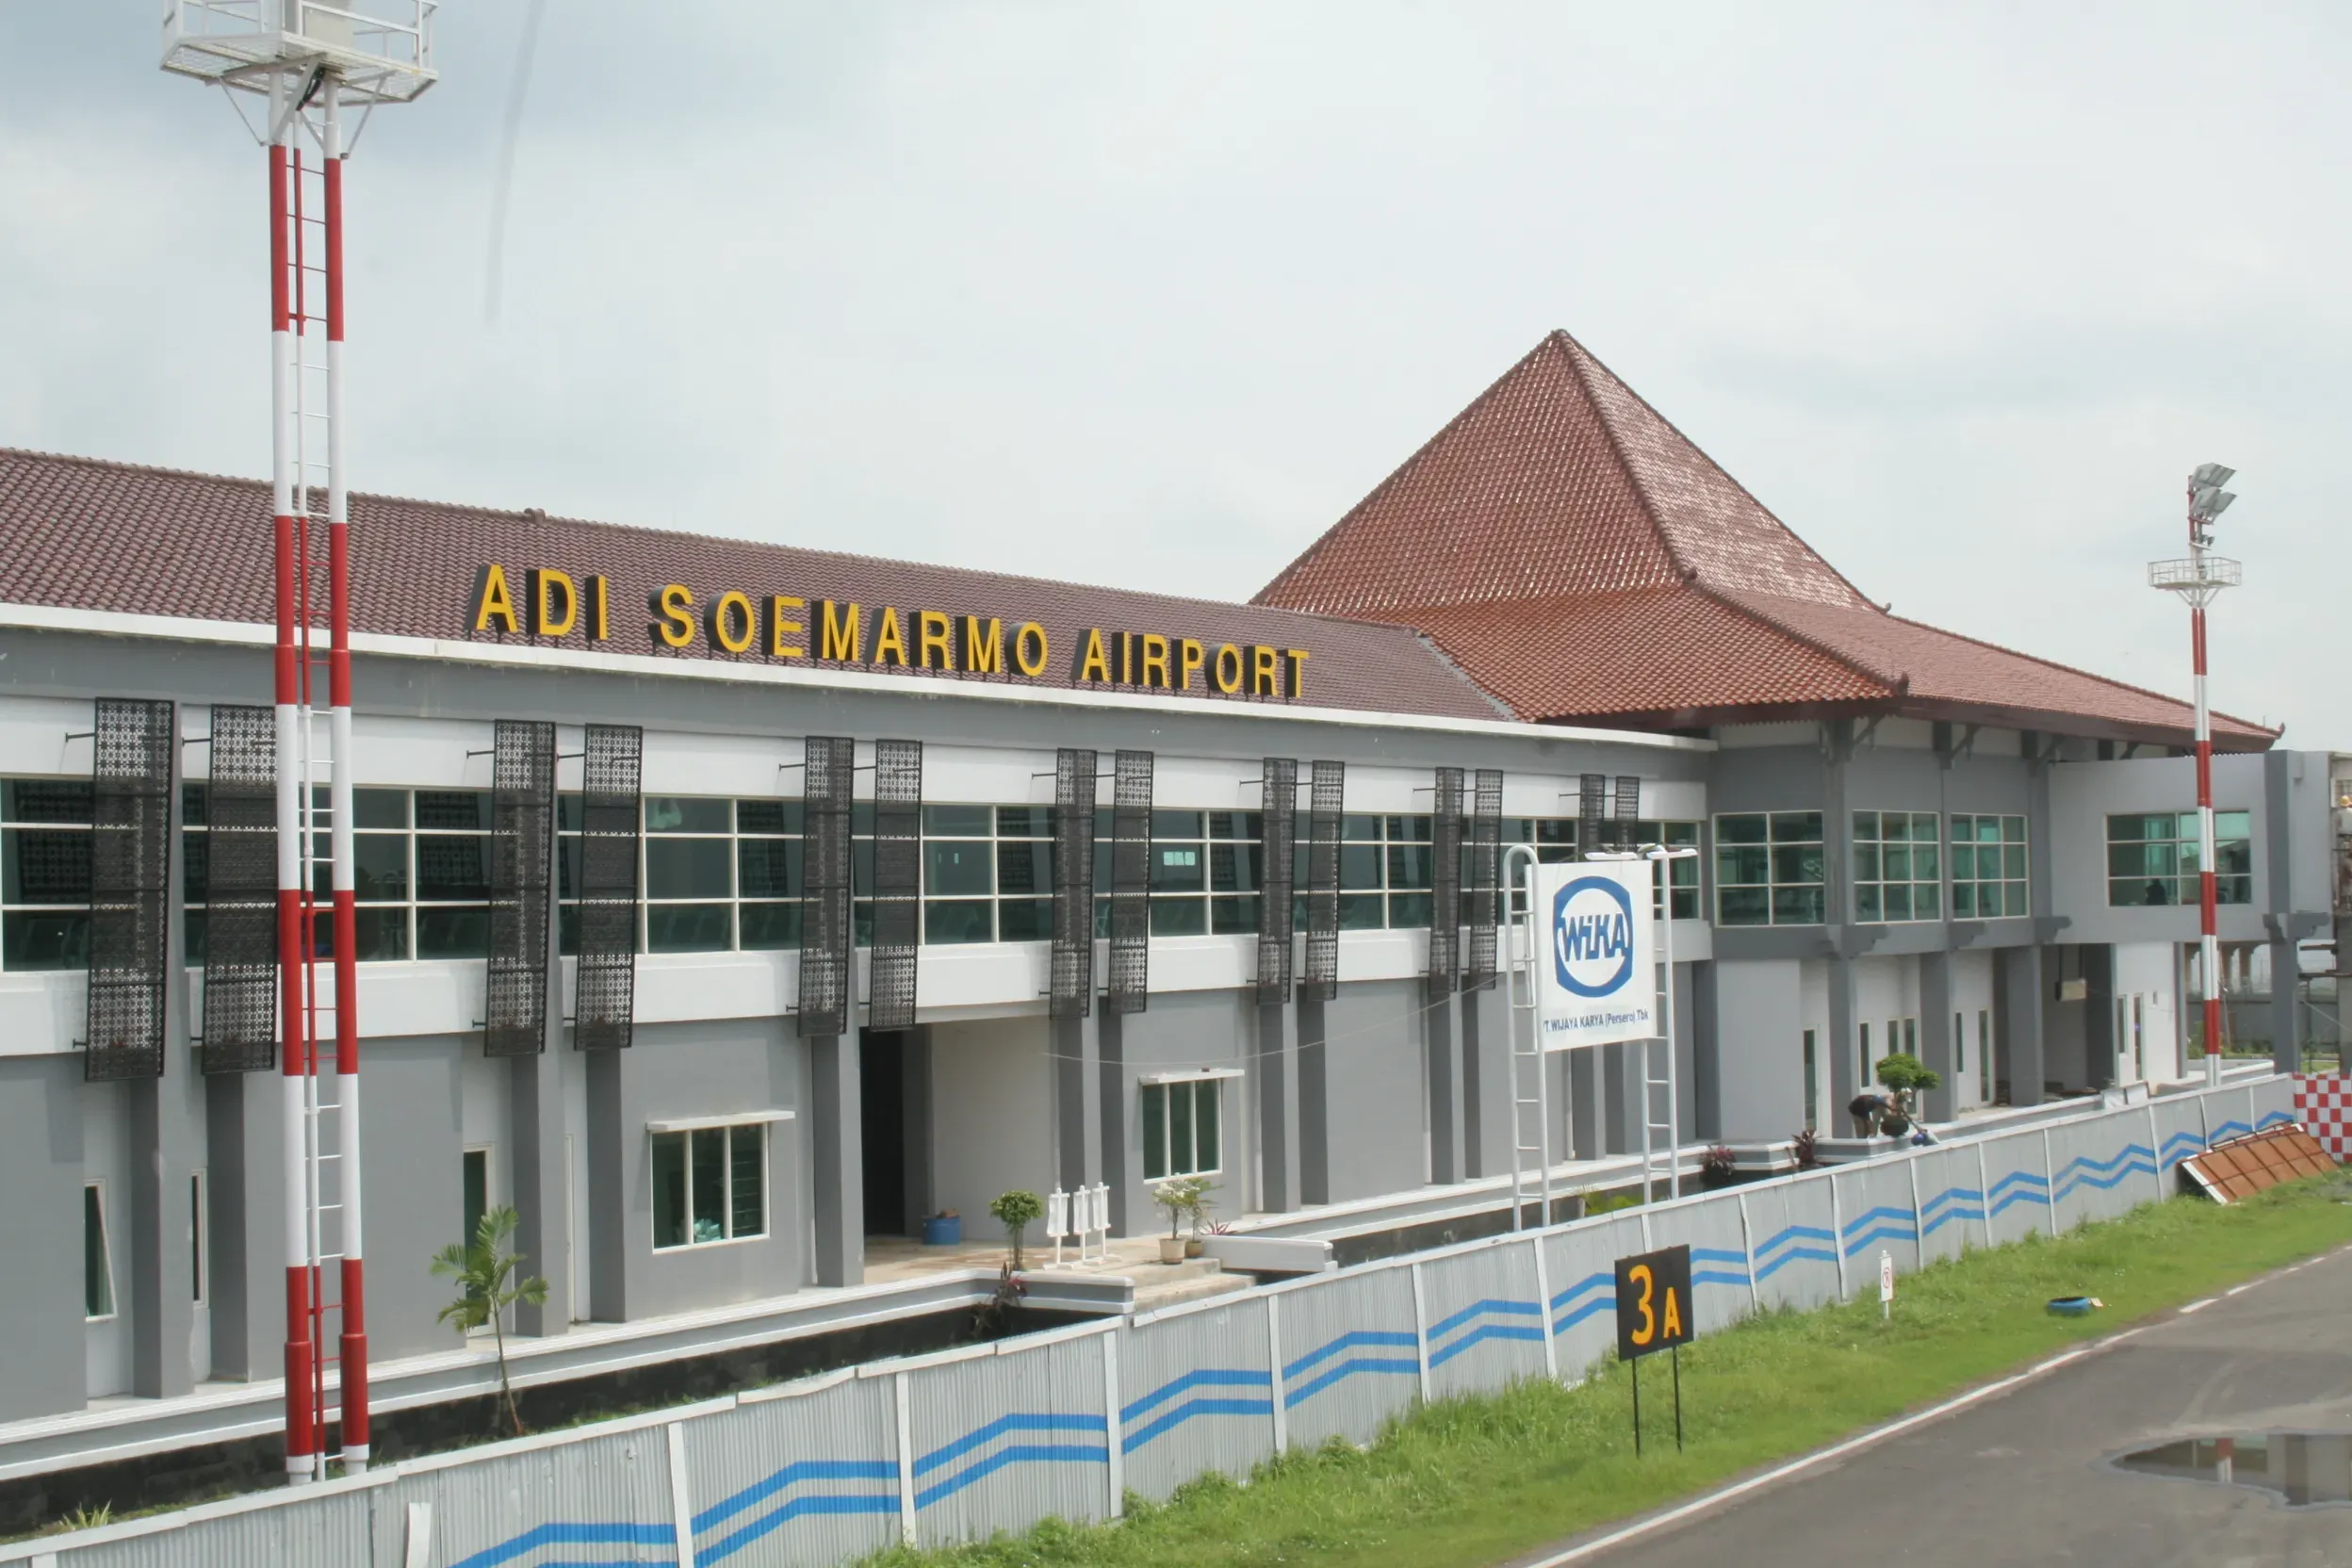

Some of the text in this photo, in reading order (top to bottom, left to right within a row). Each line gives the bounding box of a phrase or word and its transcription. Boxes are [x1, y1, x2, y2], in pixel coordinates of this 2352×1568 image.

[470, 563, 1310, 699] ADI SOEMARMO AIRPORT
[1579, 1013, 1604, 1028] KARYA
